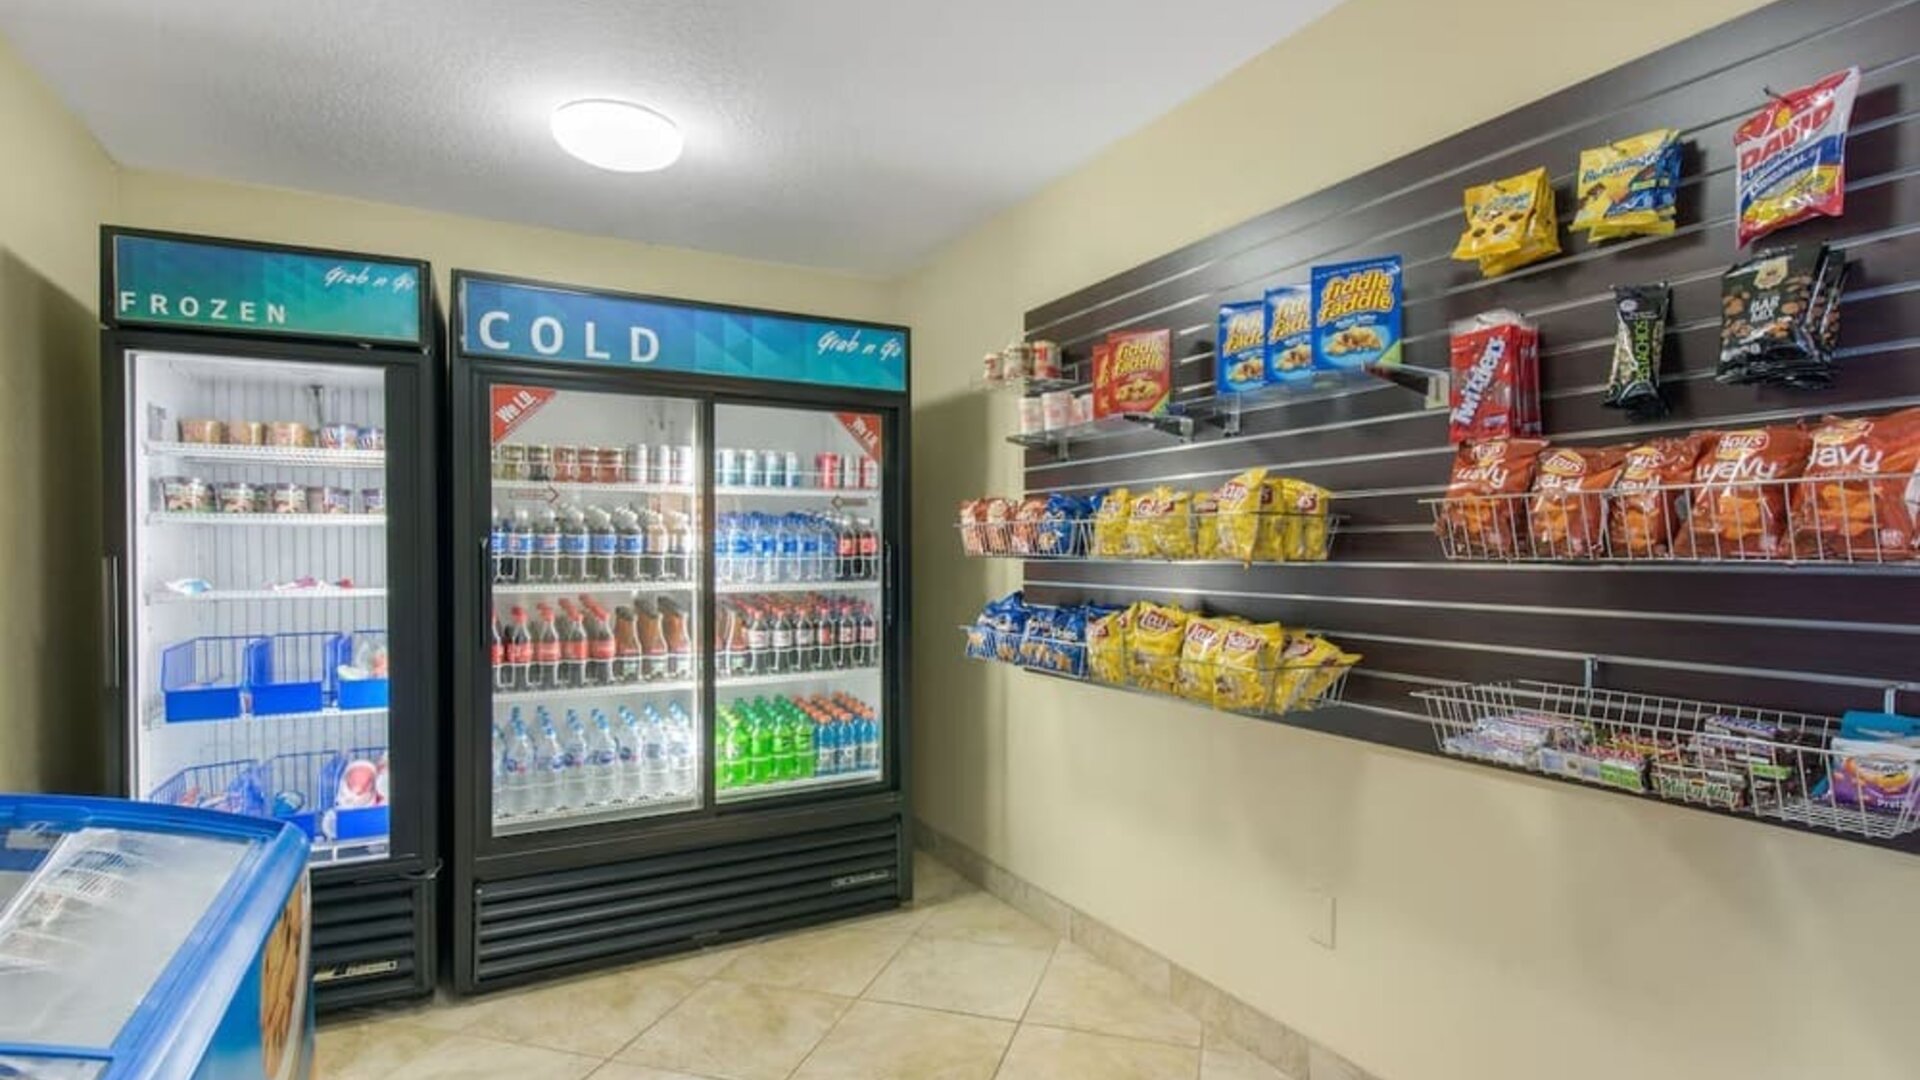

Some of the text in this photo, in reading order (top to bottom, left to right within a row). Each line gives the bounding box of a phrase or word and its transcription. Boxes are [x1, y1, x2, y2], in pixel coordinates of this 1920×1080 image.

[120, 291, 287, 325] FROZEN
[477, 310, 661, 363] COLD
[818, 329, 902, 361] Grab n Go
